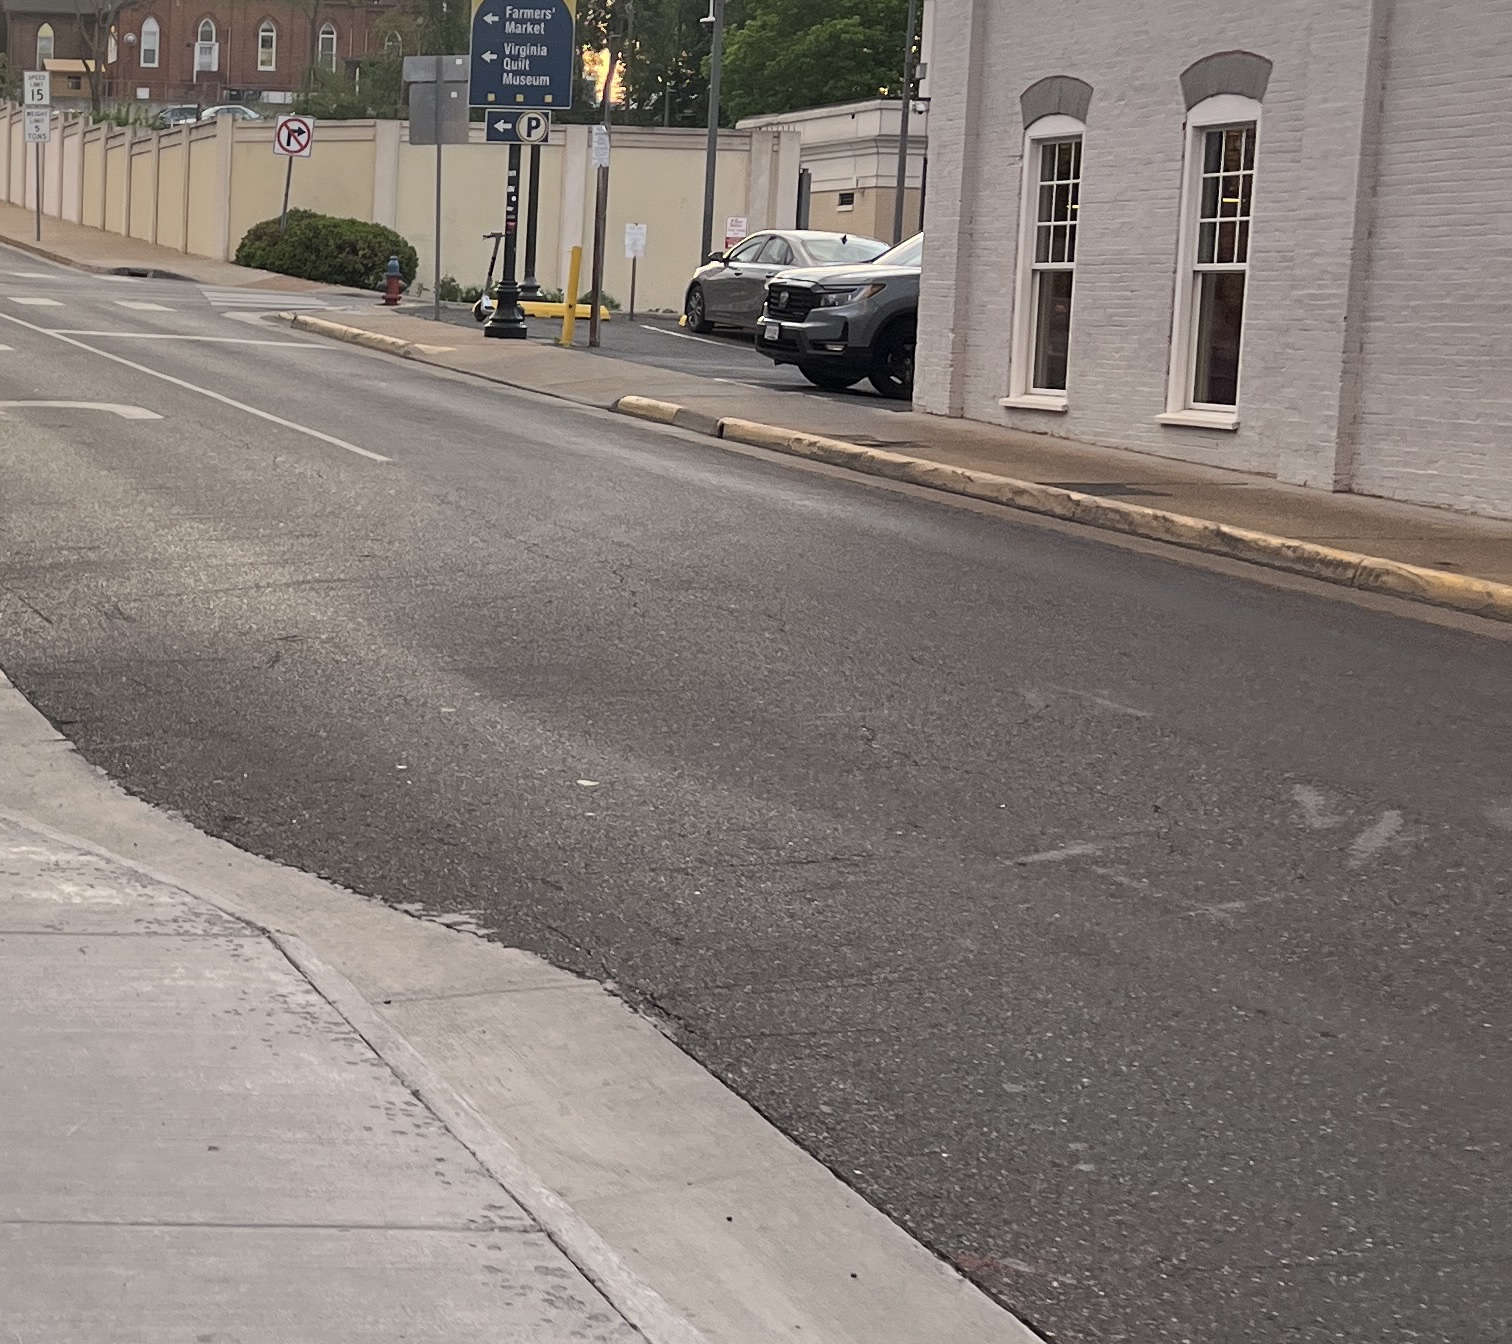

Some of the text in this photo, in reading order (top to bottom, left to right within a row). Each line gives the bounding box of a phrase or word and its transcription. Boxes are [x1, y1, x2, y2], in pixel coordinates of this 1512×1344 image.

[505, 5, 556, 20] Farmers'
[504, 21, 545, 35] Market
[503, 42, 548, 58] Virginia
[503, 58, 530, 71] Quilt
[502, 72, 550, 86] Museum
[31, 88, 44, 102] 15
[34, 125, 40, 133] 5
[526, 116, 541, 138] P
